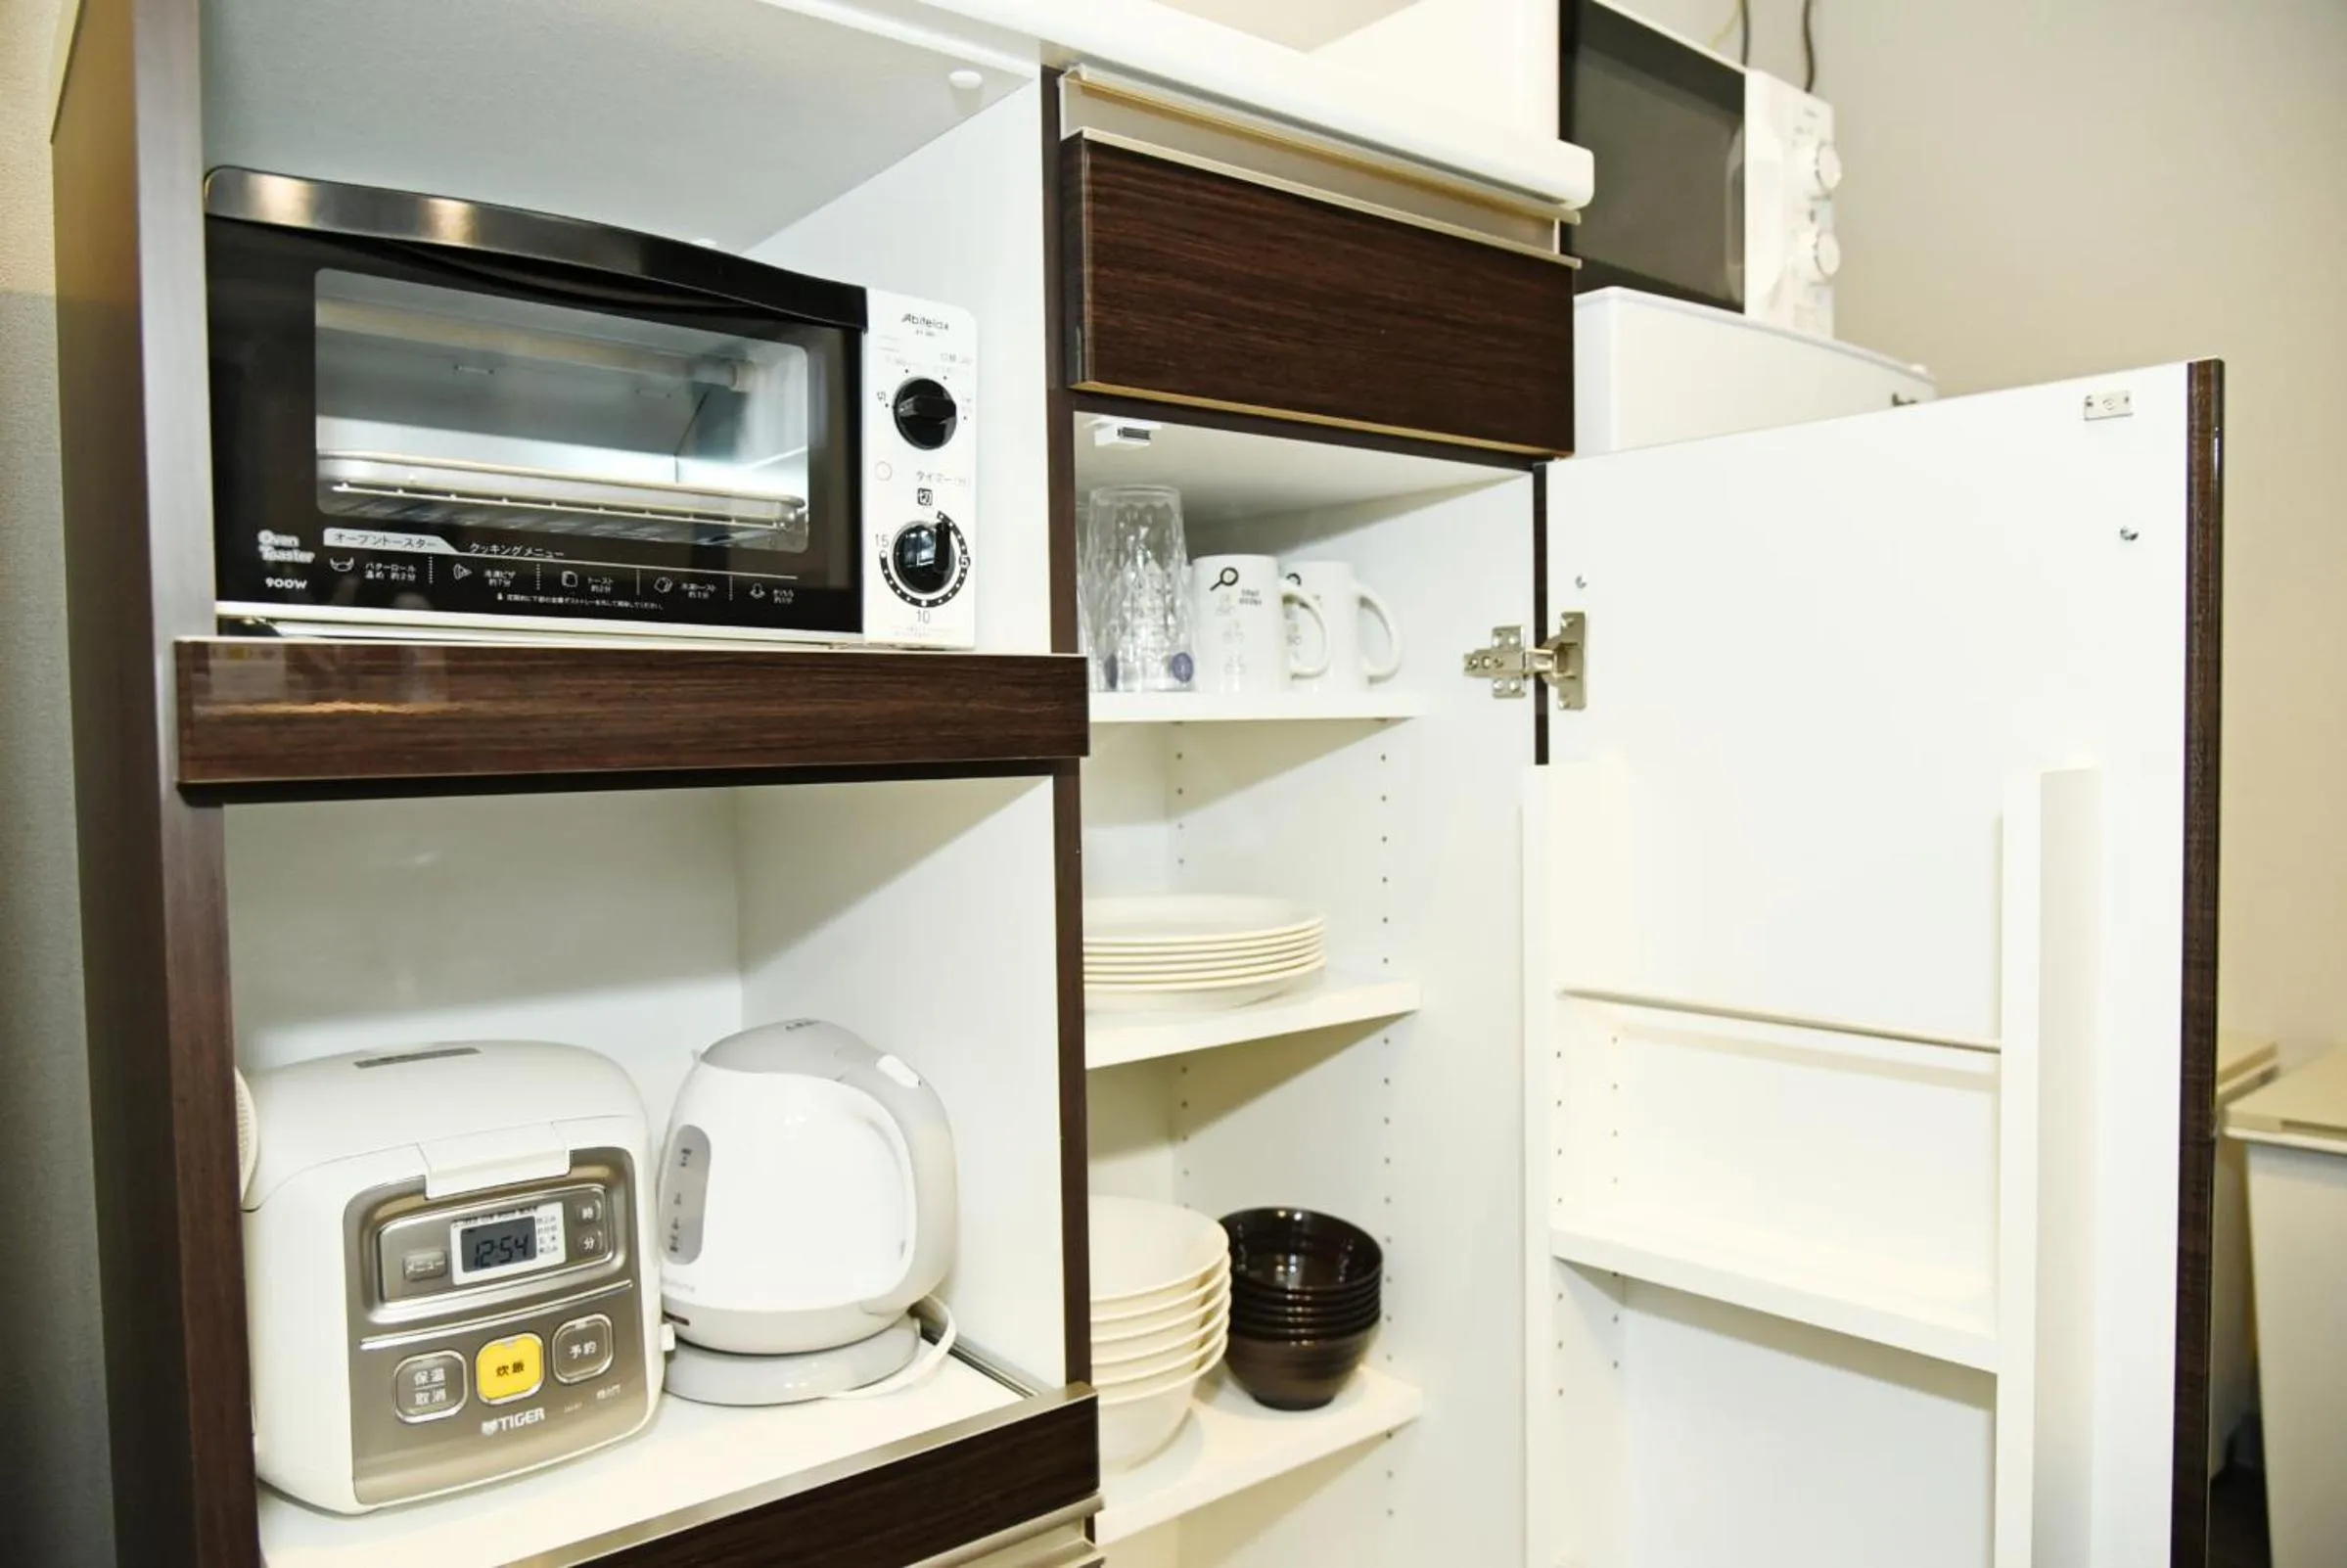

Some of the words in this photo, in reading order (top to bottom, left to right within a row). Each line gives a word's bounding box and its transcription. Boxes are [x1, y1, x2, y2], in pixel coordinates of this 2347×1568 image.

[265, 576, 308, 590] 900W
[916, 609, 931, 624] 10
[473, 1233, 529, 1268] 12:54
[570, 1341, 597, 1360] 予約
[414, 1367, 446, 1386] 保温
[495, 1360, 525, 1378] 炊飯
[415, 1389, 447, 1407] 取消
[499, 1407, 545, 1433] TIGER
